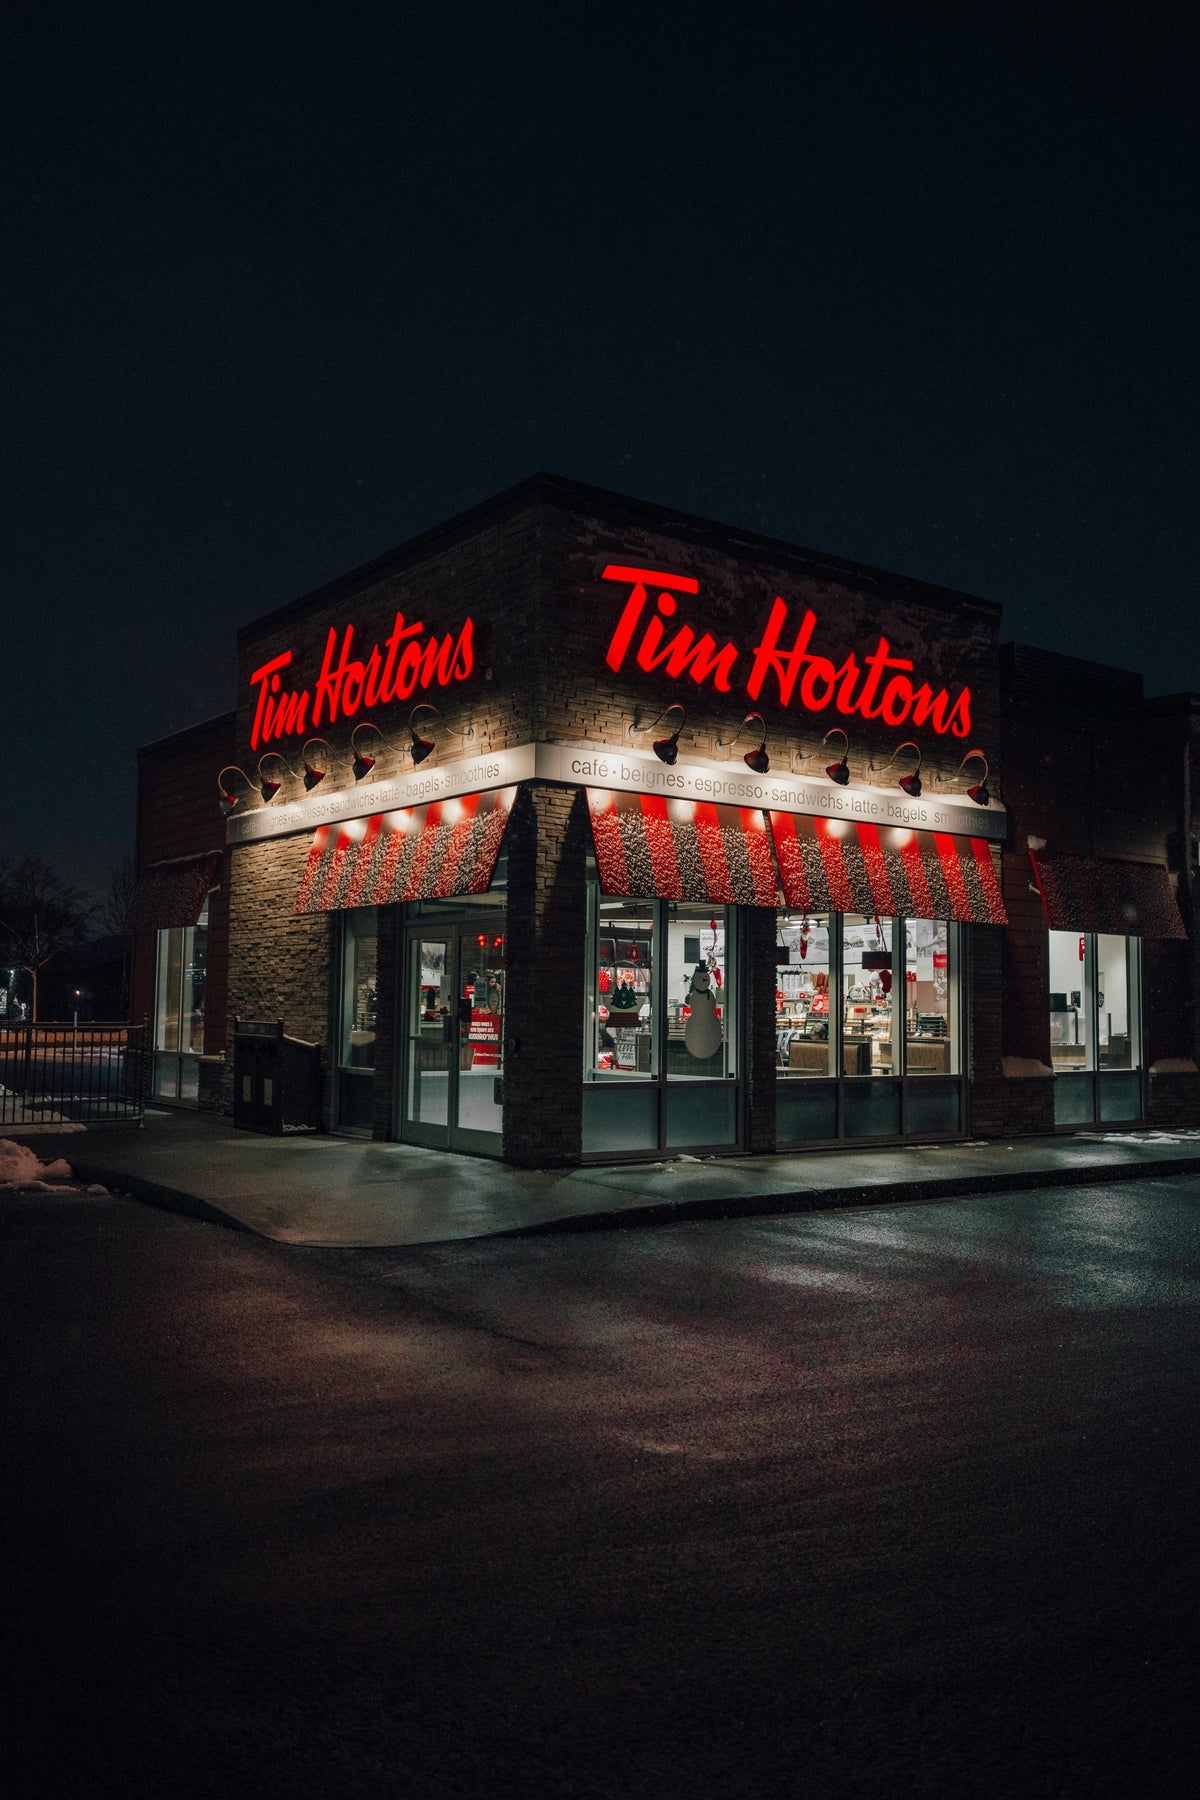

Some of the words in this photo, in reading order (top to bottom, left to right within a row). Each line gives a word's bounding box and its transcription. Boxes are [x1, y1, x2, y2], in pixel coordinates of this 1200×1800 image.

[250, 650, 309, 750] Tim
[312, 612, 473, 727] Hortons
[602, 565, 738, 692] Tim
[746, 597, 971, 738] Hortons
[291, 804, 325, 824] espresso
[330, 791, 375, 815] sandwichs
[380, 785, 400, 803] latte
[406, 776, 440, 799] bagels
[445, 762, 500, 788] smoothies
[571, 758, 608, 777] café
[621, 763, 685, 789] beignes
[694, 777, 763, 799] espresso
[771, 787, 843, 810] sandwichs
[851, 796, 879, 815] latte
[887, 802, 927, 823] bagels
[934, 811, 990, 830] smothies
